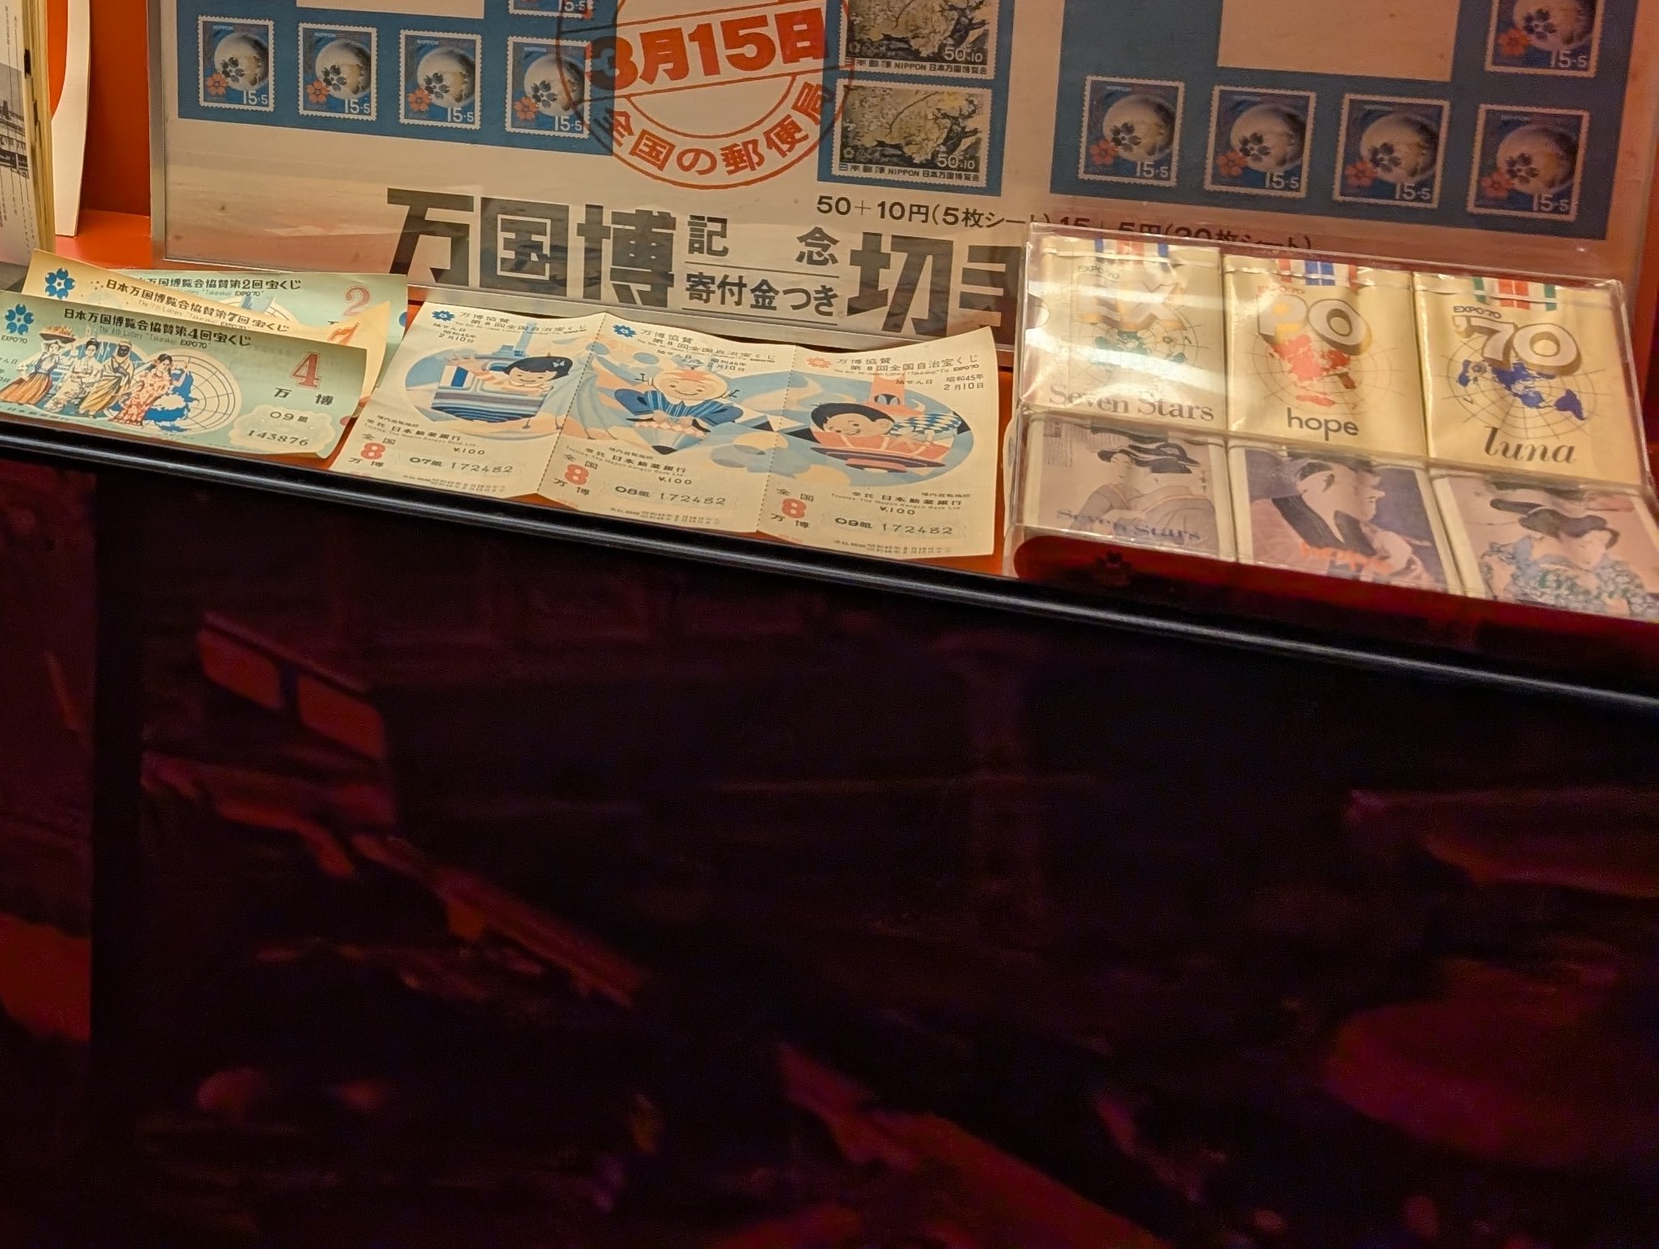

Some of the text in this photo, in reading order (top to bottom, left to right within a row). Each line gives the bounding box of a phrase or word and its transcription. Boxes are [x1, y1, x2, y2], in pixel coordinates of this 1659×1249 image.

[585, 8, 829, 91] 3月15日
[594, 81, 836, 176] 全国の郵便局
[387, 187, 675, 308] 万国博
[342, 285, 371, 317] 2
[685, 271, 840, 317] 寄付金つき
[63, 307, 252, 347] 日本万国博覧会協賛第4回宝くじ
[291, 351, 322, 390] 4
[1049, 385, 1216, 422] Seven Stars
[1286, 408, 1360, 442] hope
[361, 442, 386, 460] 8
[1484, 426, 1577, 464] luna
[564, 463, 589, 485] 8
[781, 498, 807, 519] 8
